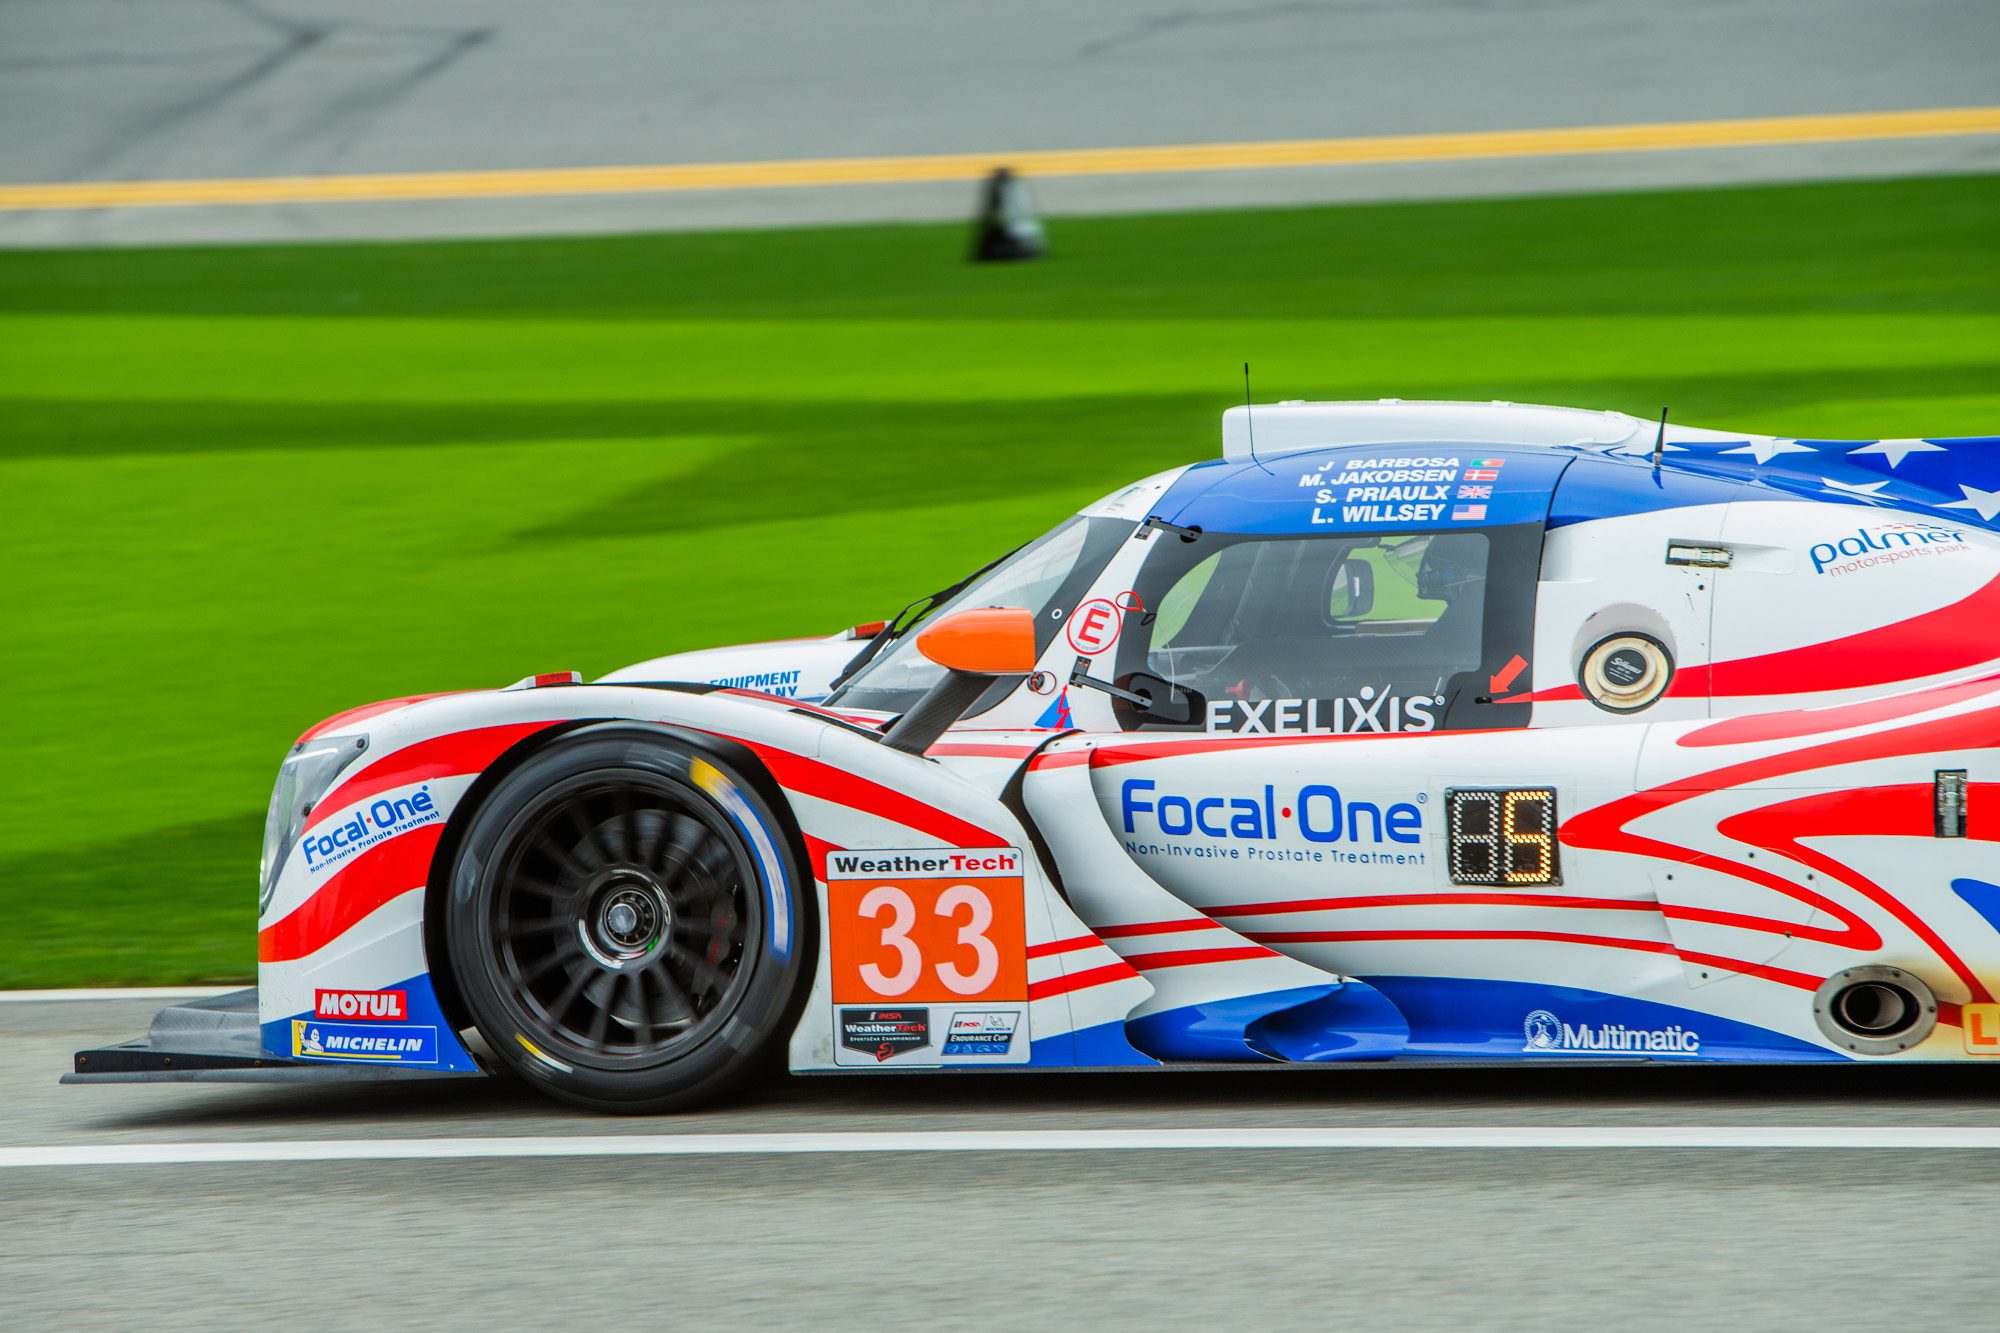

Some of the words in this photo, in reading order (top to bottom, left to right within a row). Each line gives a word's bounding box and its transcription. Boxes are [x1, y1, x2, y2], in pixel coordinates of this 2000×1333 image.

[1318, 461, 1334, 472] J
[1345, 457, 1460, 470] BARBOSA
[1299, 474, 1326, 487] M.
[1331, 469, 1458, 485] JAKOBSEN
[1315, 489, 1337, 504] S.
[1346, 485, 1451, 502] PRIAULX
[1311, 508, 1334, 524] L.
[1342, 504, 1446, 523] WILLSEY
[1810, 528, 1967, 574] palmer
[1829, 545, 1931, 577] motorsports
[1935, 543, 1970, 556] park
[1078, 608, 1111, 645] E
[310, 846, 357, 873] Non-Invasive
[358, 830, 393, 848] Prostate
[394, 811, 441, 833] Treatment
[1125, 841, 1239, 860] Non-Invasive
[1248, 847, 1323, 862] Prostate
[1331, 850, 1426, 865] Treatment
[857, 885, 999, 997] 33
[319, 993, 401, 1017] MOTUL
[1562, 1023, 1699, 1051] Multimatic
[1969, 1013, 2000, 1045] L
[325, 1036, 423, 1052] MICHELIN
